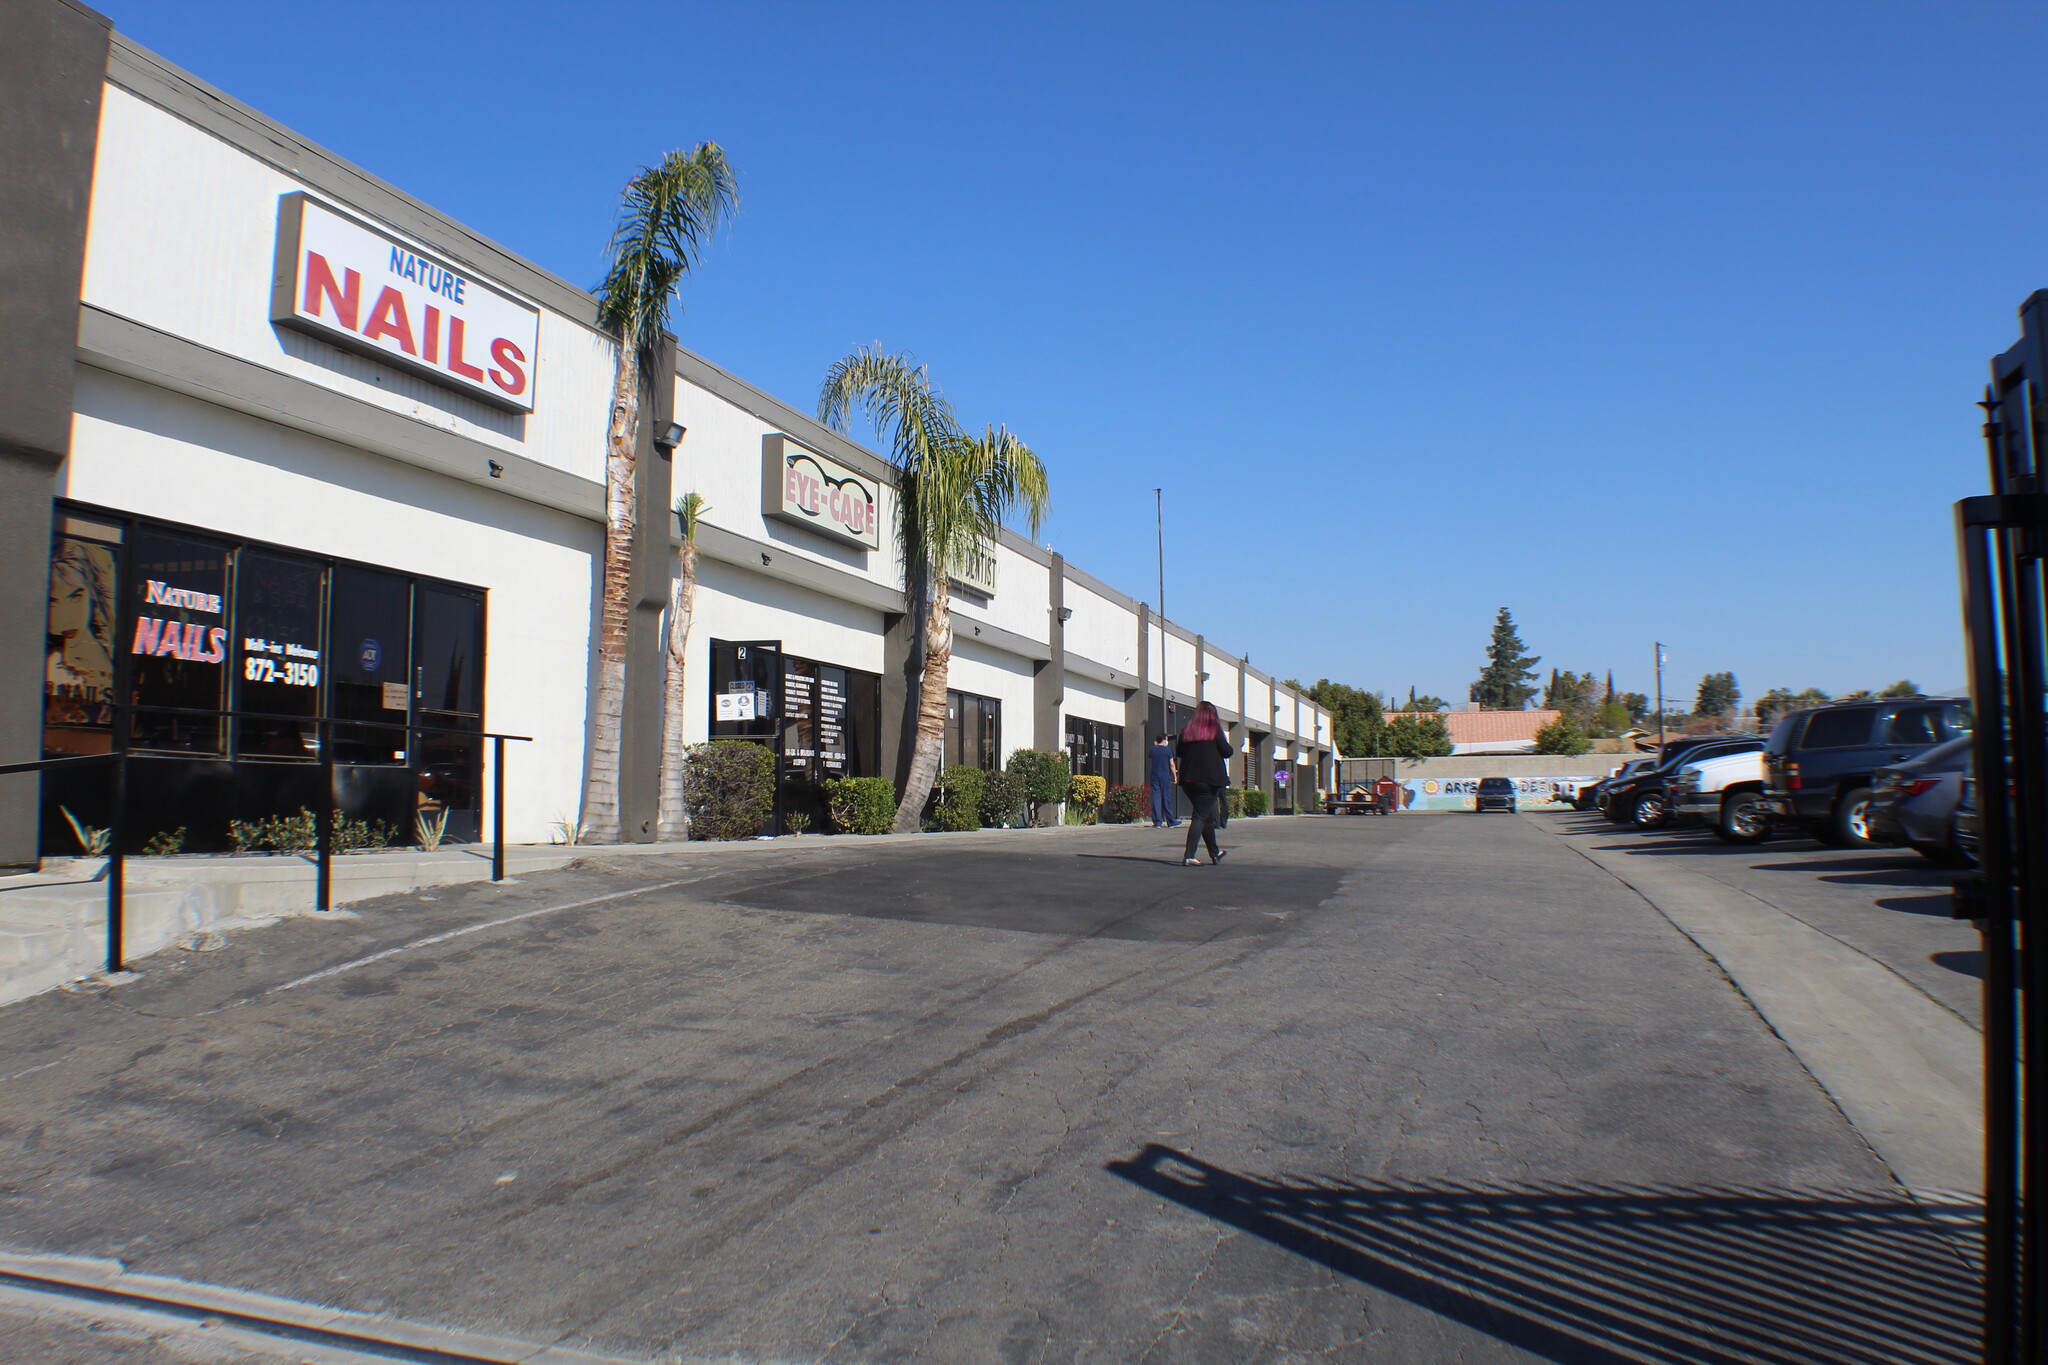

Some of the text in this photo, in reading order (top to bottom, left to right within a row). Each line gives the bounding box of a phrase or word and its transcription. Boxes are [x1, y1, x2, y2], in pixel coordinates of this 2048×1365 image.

[389, 245, 467, 306] NATURE
[303, 250, 527, 395] NAILS
[786, 467, 874, 535] EYE-CARE
[145, 579, 222, 614] NATURE
[132, 616, 228, 664] NAILS
[739, 647, 745, 658] 2
[245, 657, 319, 687] 872-3150
[1445, 780, 1479, 795] ARTS
